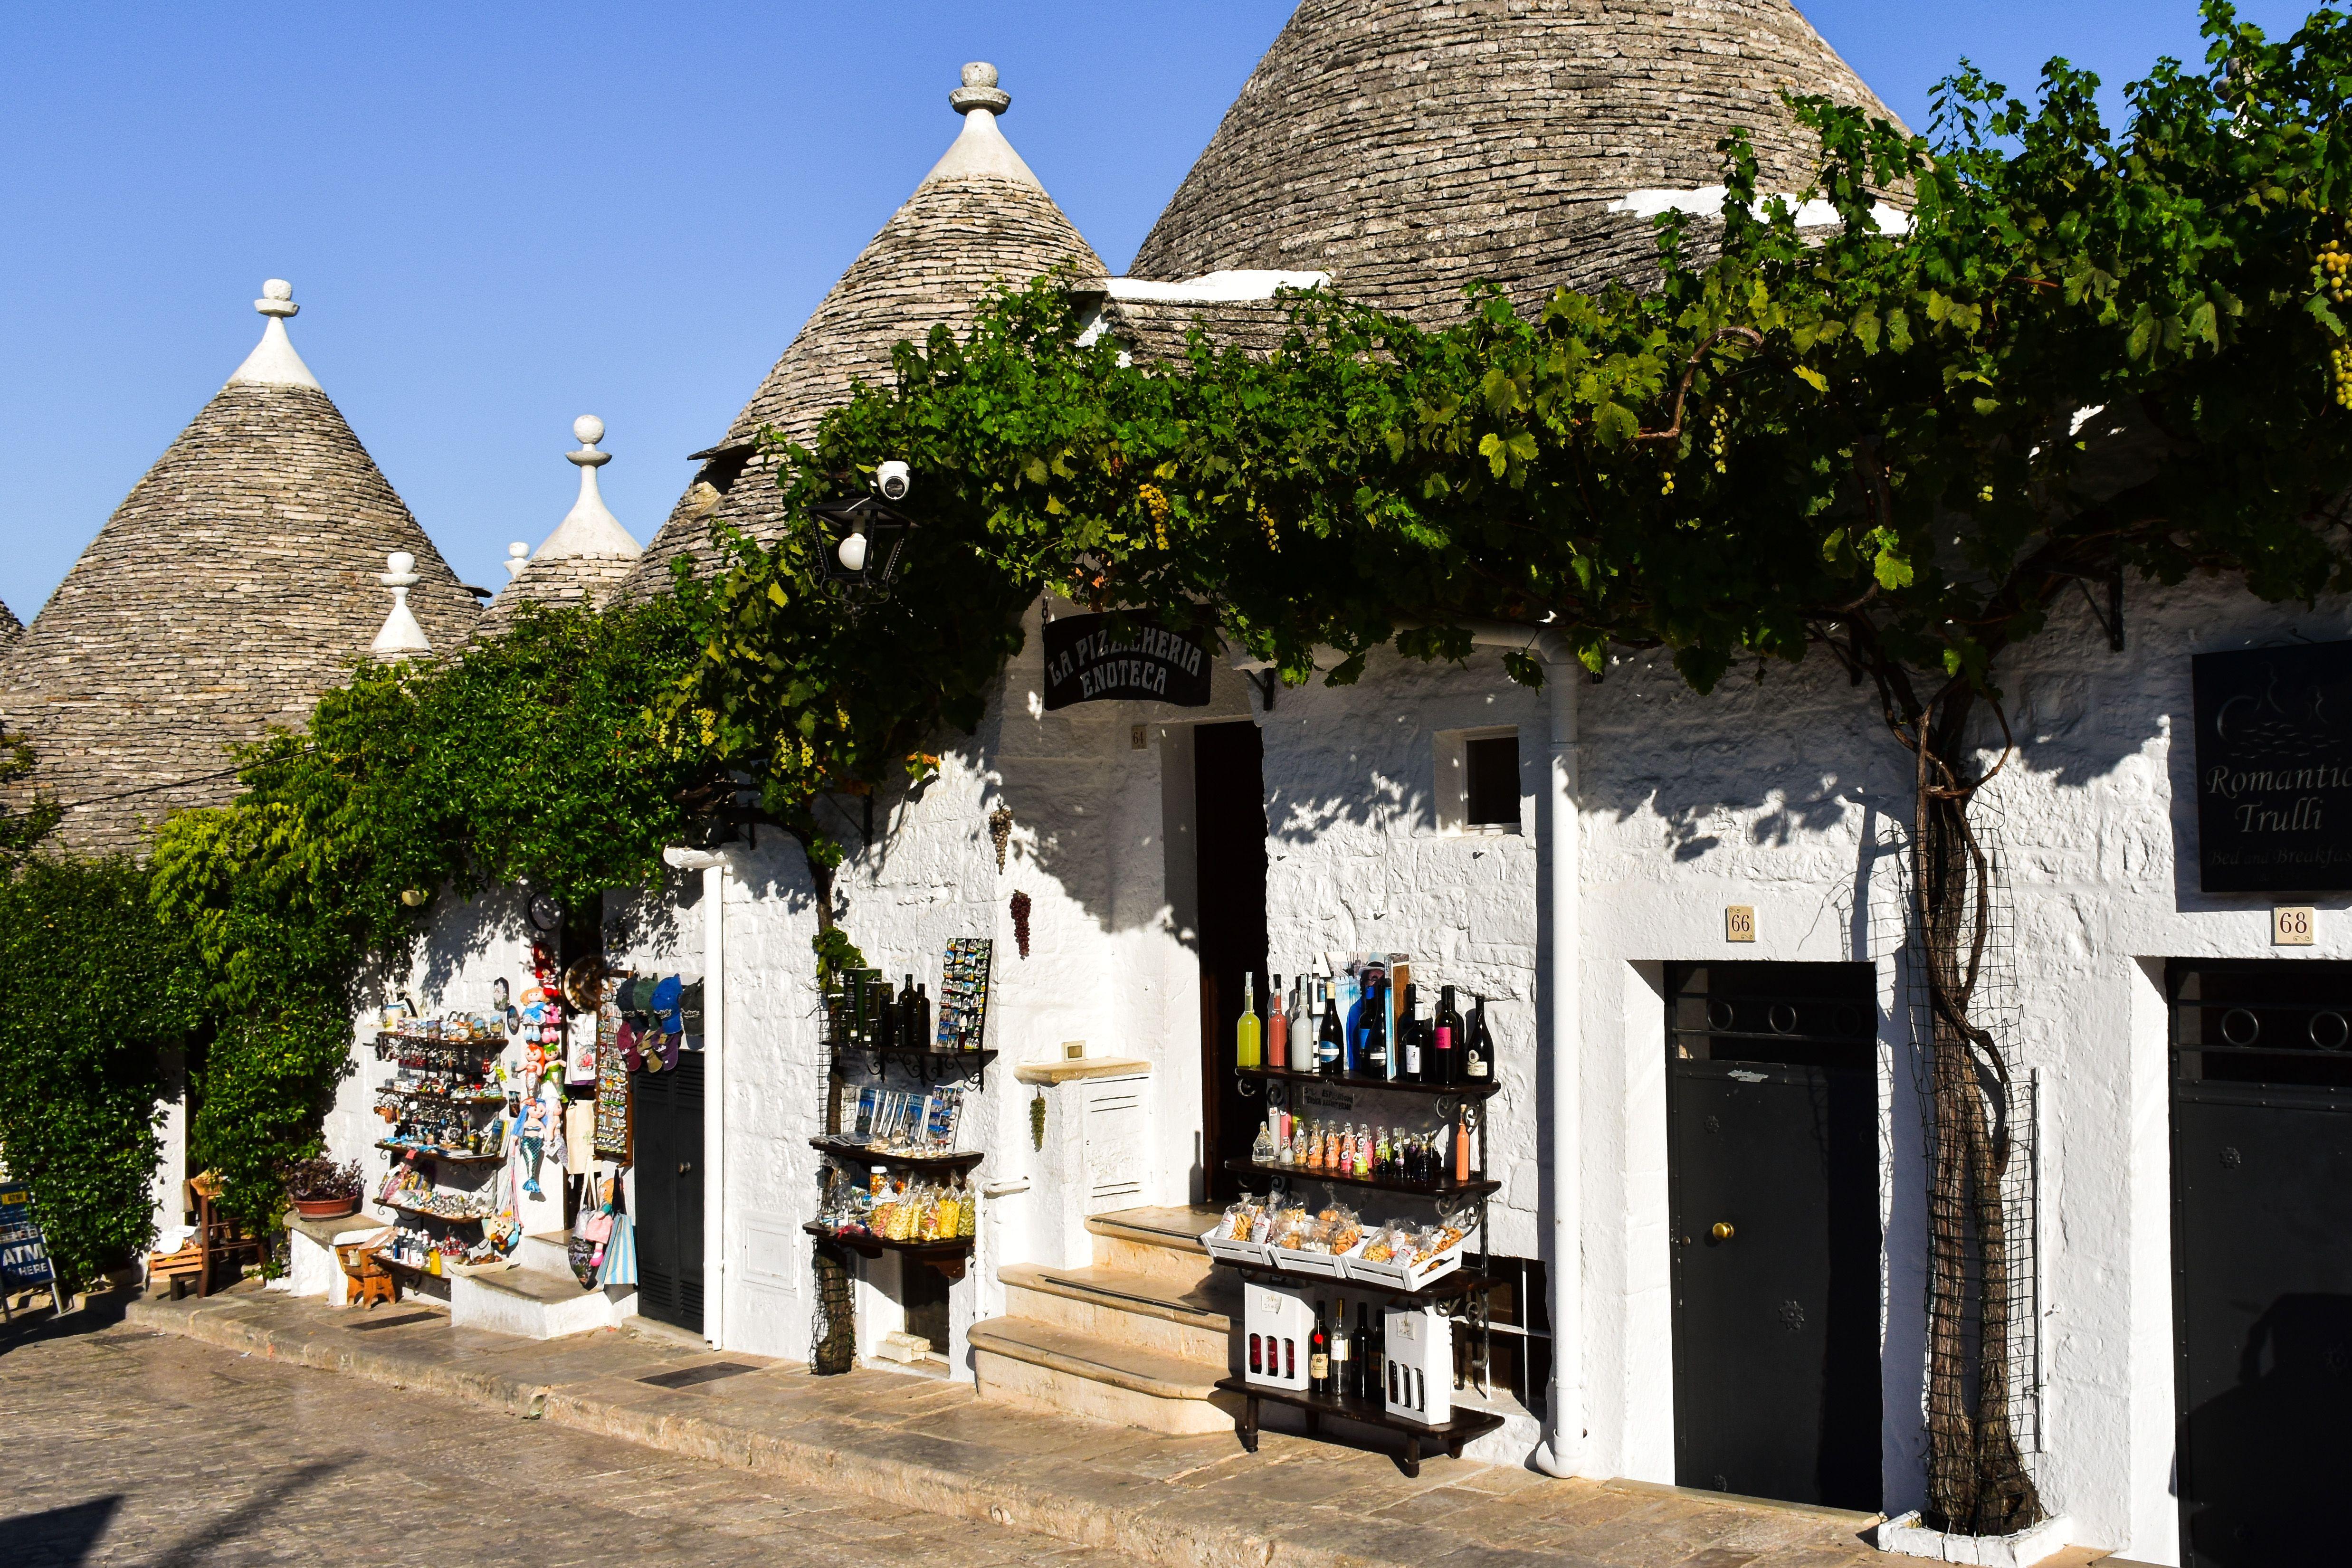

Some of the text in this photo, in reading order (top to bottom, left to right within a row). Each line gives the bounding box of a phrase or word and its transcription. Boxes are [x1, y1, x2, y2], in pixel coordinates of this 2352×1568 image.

[1047, 627, 1202, 687] LA PIZZCHERIA
[1080, 660, 1167, 699] ENOTECA
[2206, 757, 2352, 799] Romantic
[2235, 796, 2324, 832] Trulli
[2208, 846, 2242, 866] Bed
[2243, 850, 2270, 865] and
[1732, 914, 1750, 931] 66
[2279, 911, 2307, 935] 68
[3, 1243, 45, 1266] ATM
[19, 1263, 48, 1276] HERE
